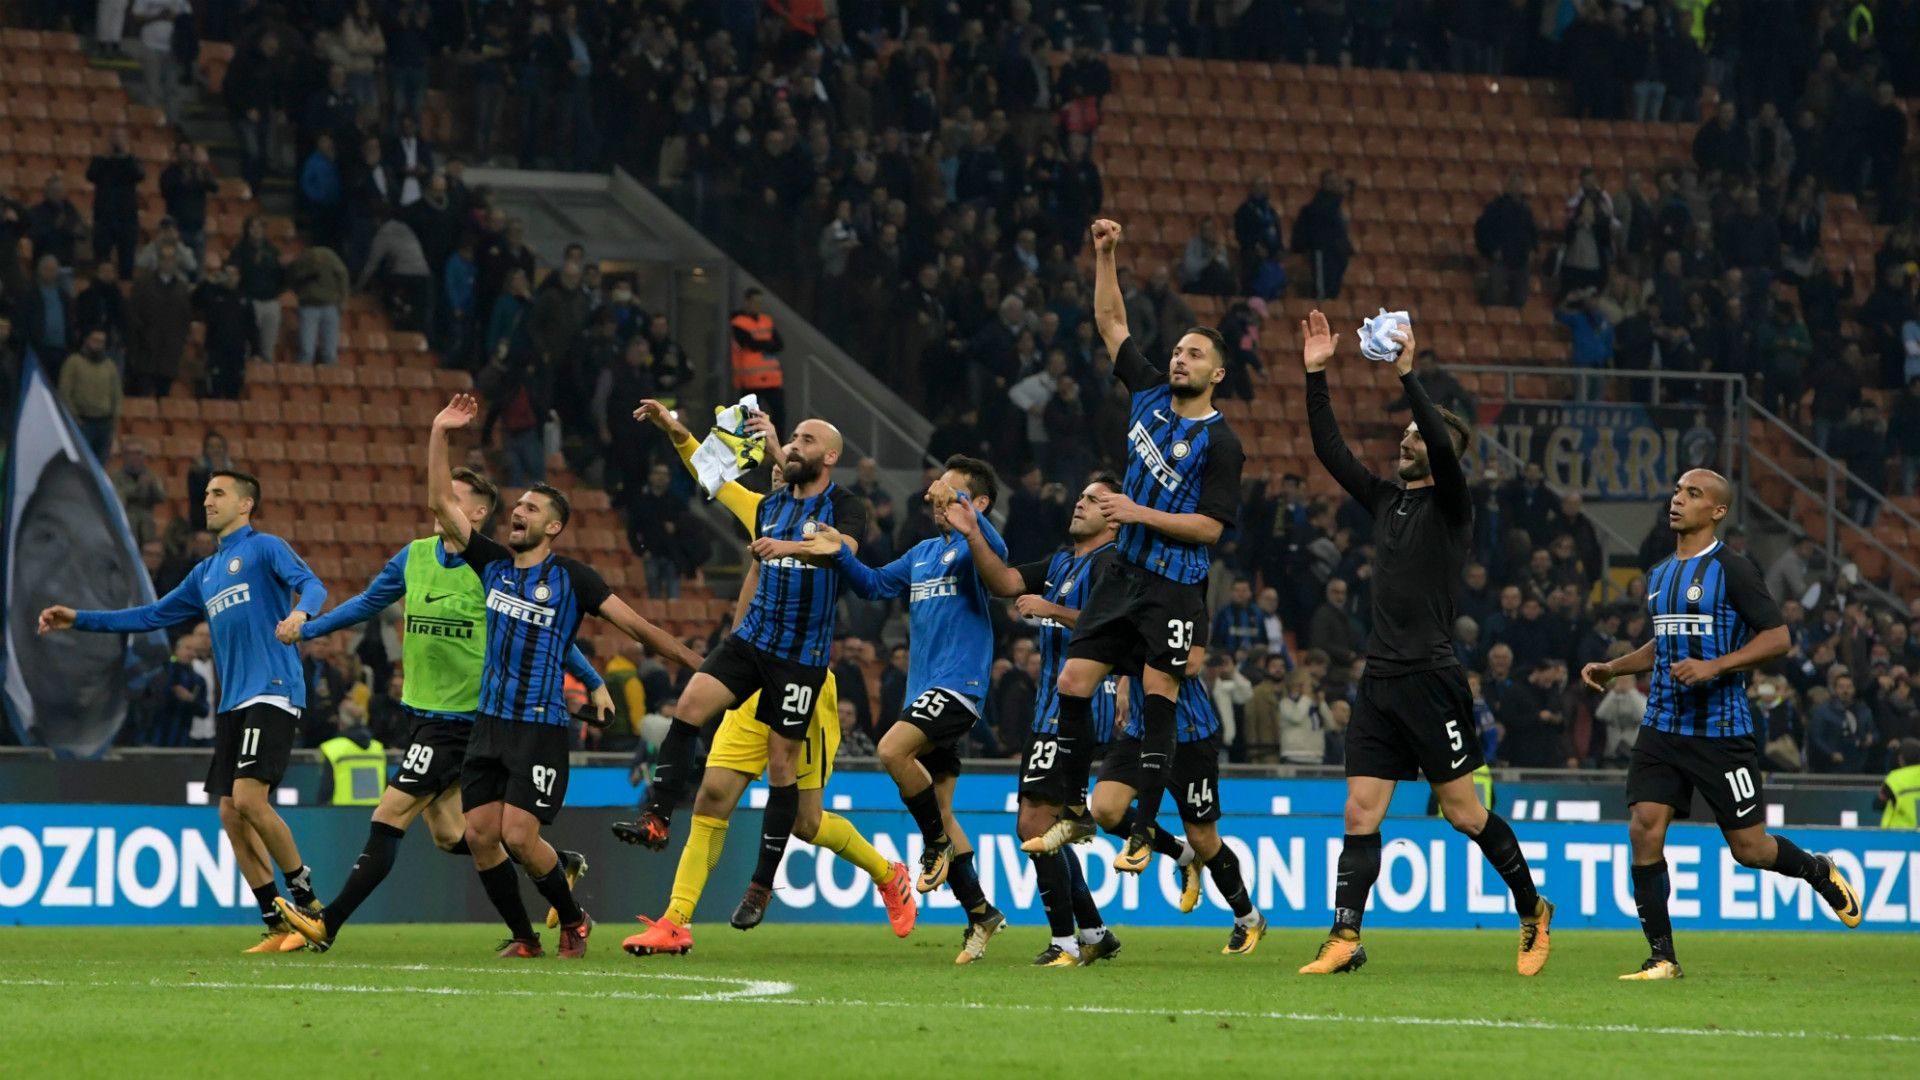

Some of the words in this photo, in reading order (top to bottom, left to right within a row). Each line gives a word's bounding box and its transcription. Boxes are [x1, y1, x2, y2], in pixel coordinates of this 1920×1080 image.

[1128, 420, 1183, 492] PIRELLI
[486, 588, 556, 627] PIRELLI
[406, 614, 474, 639] PIRELLI
[1167, 619, 1194, 651] 33
[781, 683, 813, 715] 20
[911, 690, 950, 718] 55
[241, 728, 261, 756] 11
[1445, 719, 1464, 751] 5
[402, 743, 434, 775] 99
[1028, 740, 1058, 770] 23
[532, 765, 557, 796] 87
[1186, 778, 1213, 807] 44
[1725, 767, 1756, 802] 10
